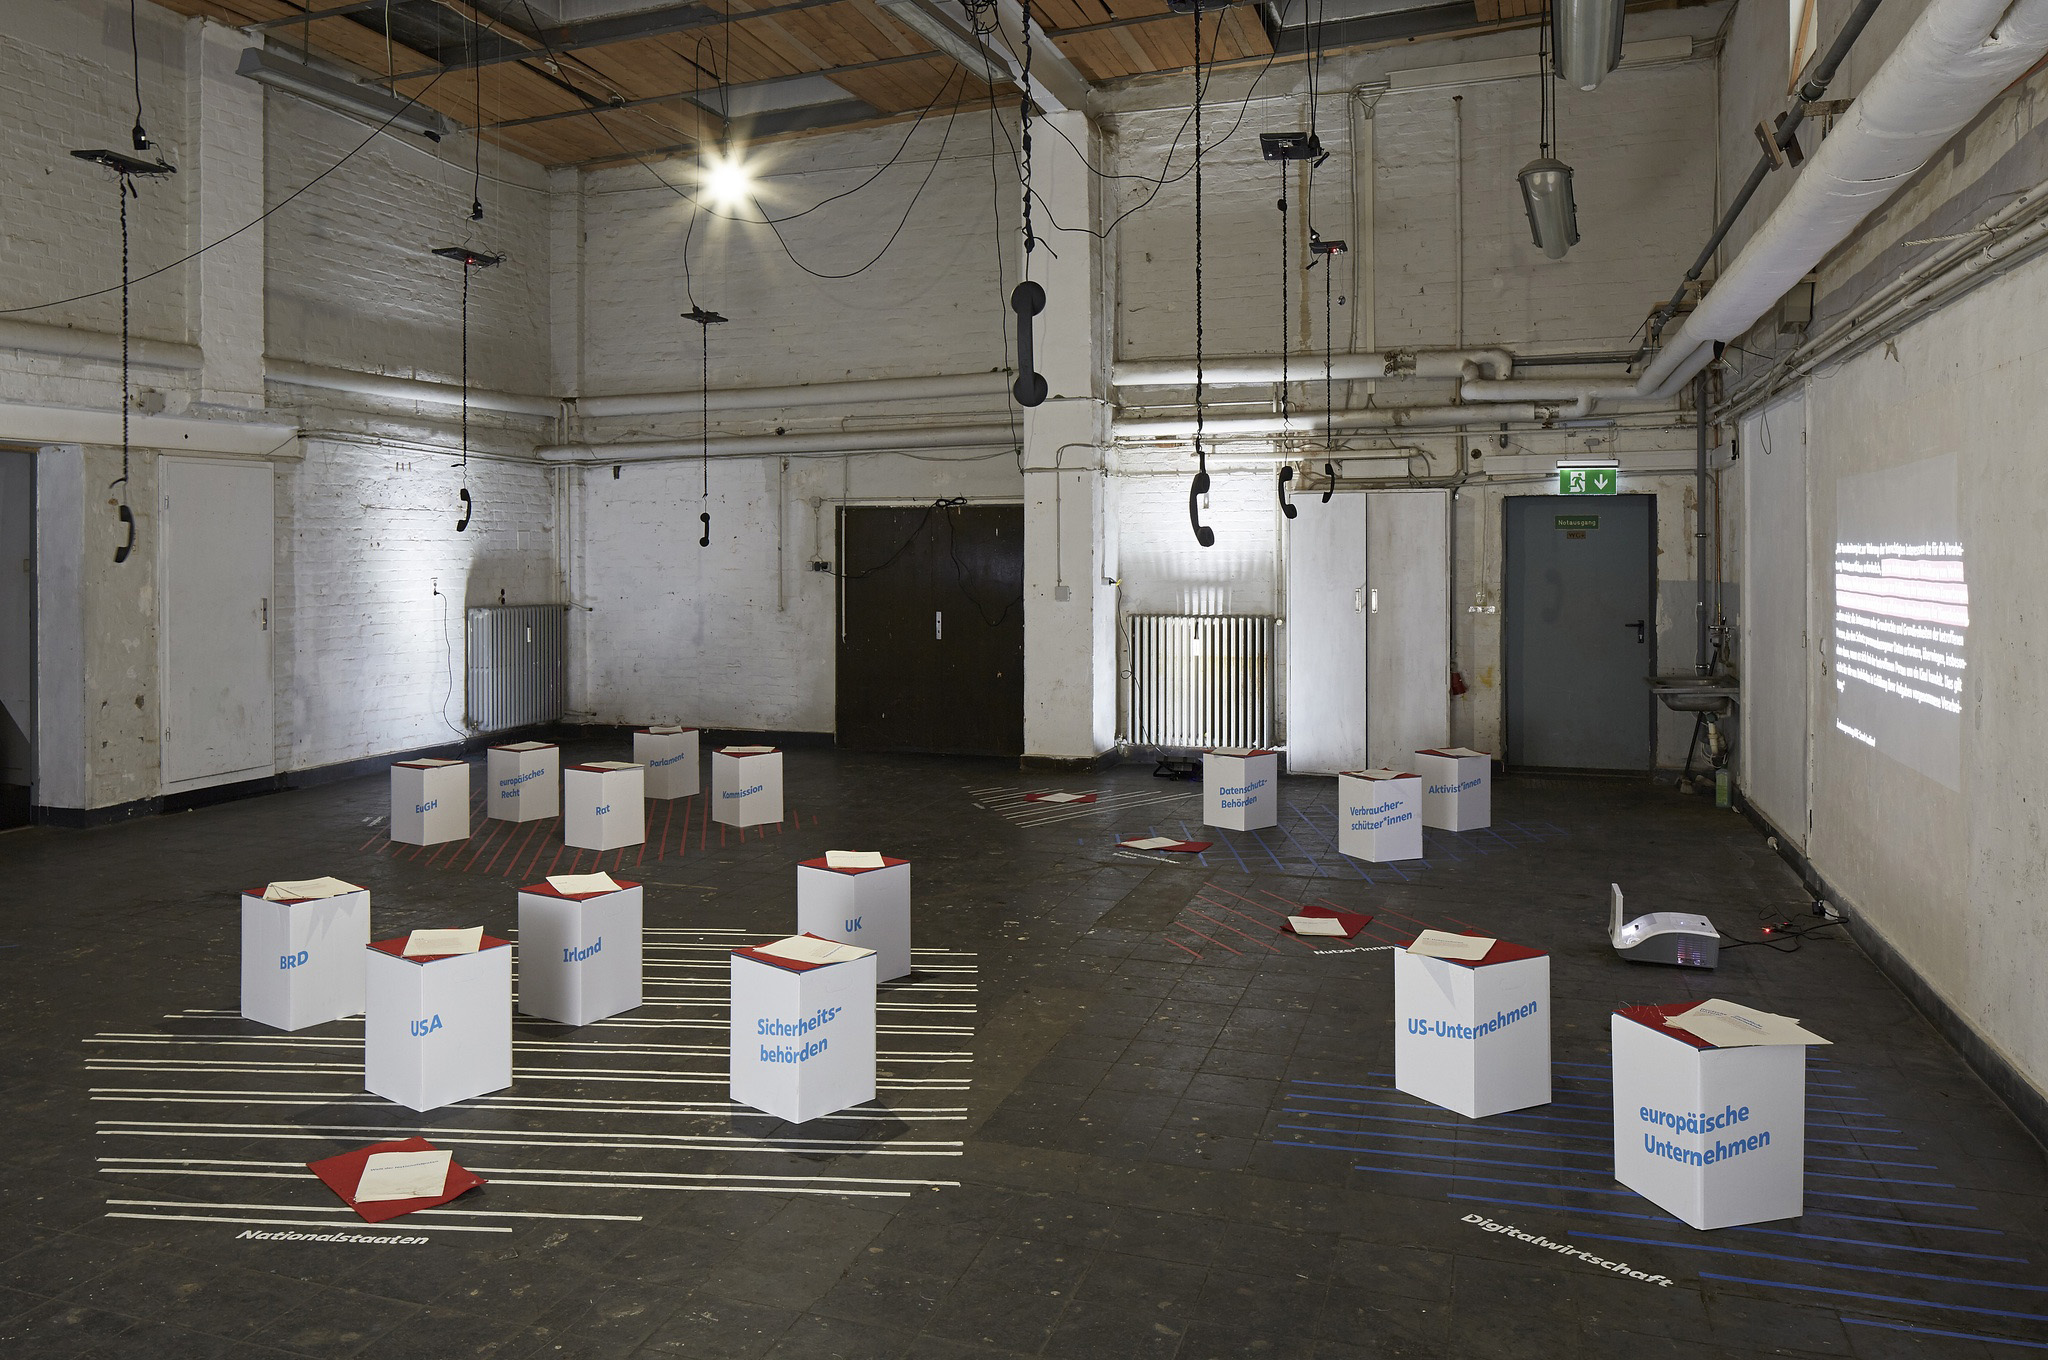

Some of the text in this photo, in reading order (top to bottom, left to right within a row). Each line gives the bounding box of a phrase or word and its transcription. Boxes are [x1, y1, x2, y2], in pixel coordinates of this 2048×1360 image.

[1558, 519, 1596, 527] Notausgang
[649, 751, 685, 768] Parlament
[499, 767, 545, 787] europäisches
[501, 787, 520, 799] Recht
[722, 783, 763, 800] Kommission
[1219, 778, 1268, 797] Datenschutz-
[415, 799, 438, 814] EuGH
[595, 804, 611, 816] Rat
[1221, 794, 1258, 809] Behörden
[1349, 800, 1404, 817] Verbraucher-
[845, 916, 863, 933] UK
[562, 936, 603, 964] Irland
[280, 949, 309, 971] BRD
[410, 1013, 443, 1038] USA
[757, 1004, 843, 1040] Sicherheits-
[1407, 998, 1538, 1041] US-Unternehmen
[759, 1036, 829, 1065] behörden
[1639, 1103, 1750, 1136] europäische
[1643, 1127, 1771, 1167] Unternehmen
[235, 1229, 430, 1246] Nationalstaaten
[1460, 1212, 1675, 1288] Digitalwirtschaft
